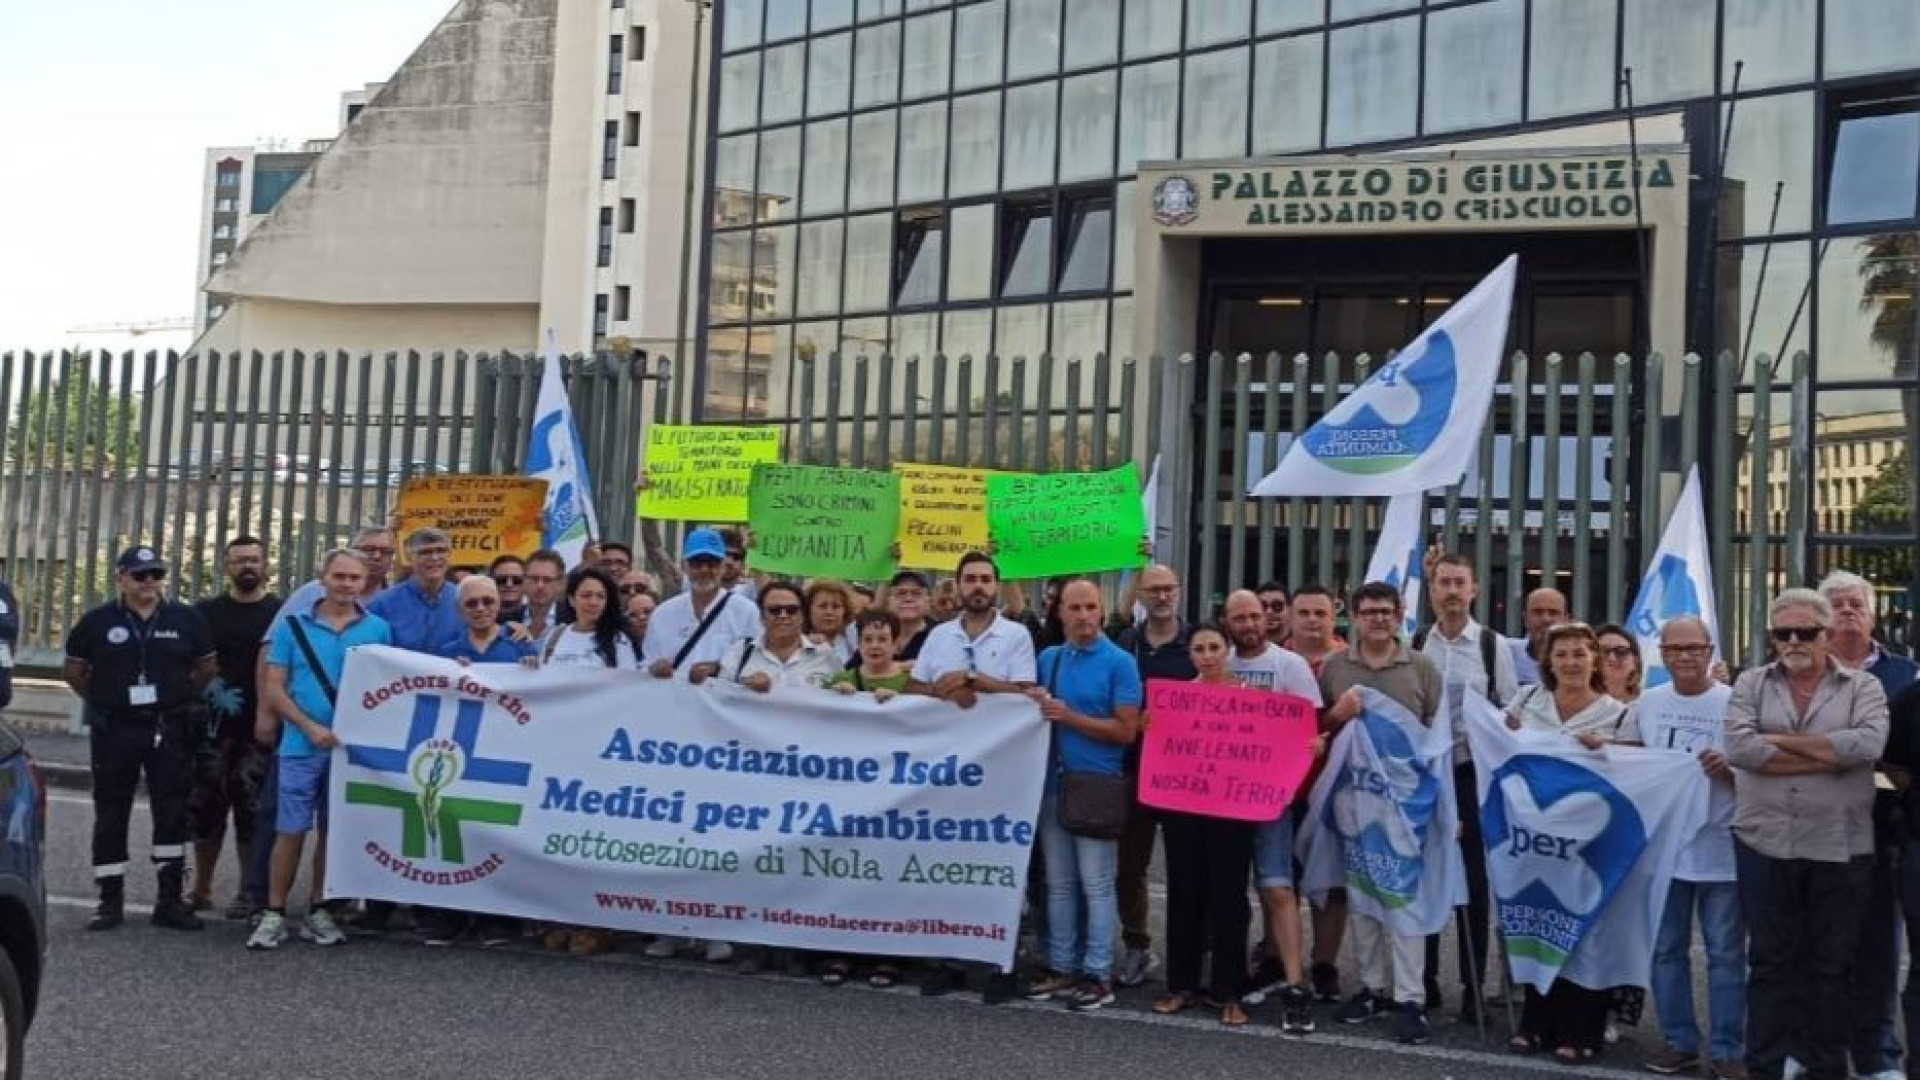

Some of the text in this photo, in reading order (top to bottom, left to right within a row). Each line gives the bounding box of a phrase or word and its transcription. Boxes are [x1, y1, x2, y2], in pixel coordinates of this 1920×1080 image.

[1211, 168, 1392, 200] PALAZZO
[1247, 194, 1633, 225] ALESSANDRO CRISCUOLO
[362, 674, 532, 726] doctors for the
[1153, 688, 1239, 715] CONFISCA
[1264, 698, 1304, 719] BENI
[600, 726, 985, 787] Associazione Isde
[1162, 736, 1273, 764] AVVELENATO
[1151, 772, 1211, 795] NOSTRA
[540, 777, 1033, 847] Medici per l'Ambiente
[543, 829, 1017, 888] sottosezione di Nola Acerra
[1508, 822, 1580, 861] per
[364, 840, 505, 886] environment
[761, 907, 1007, 942] isdenolacerra@libero.it
